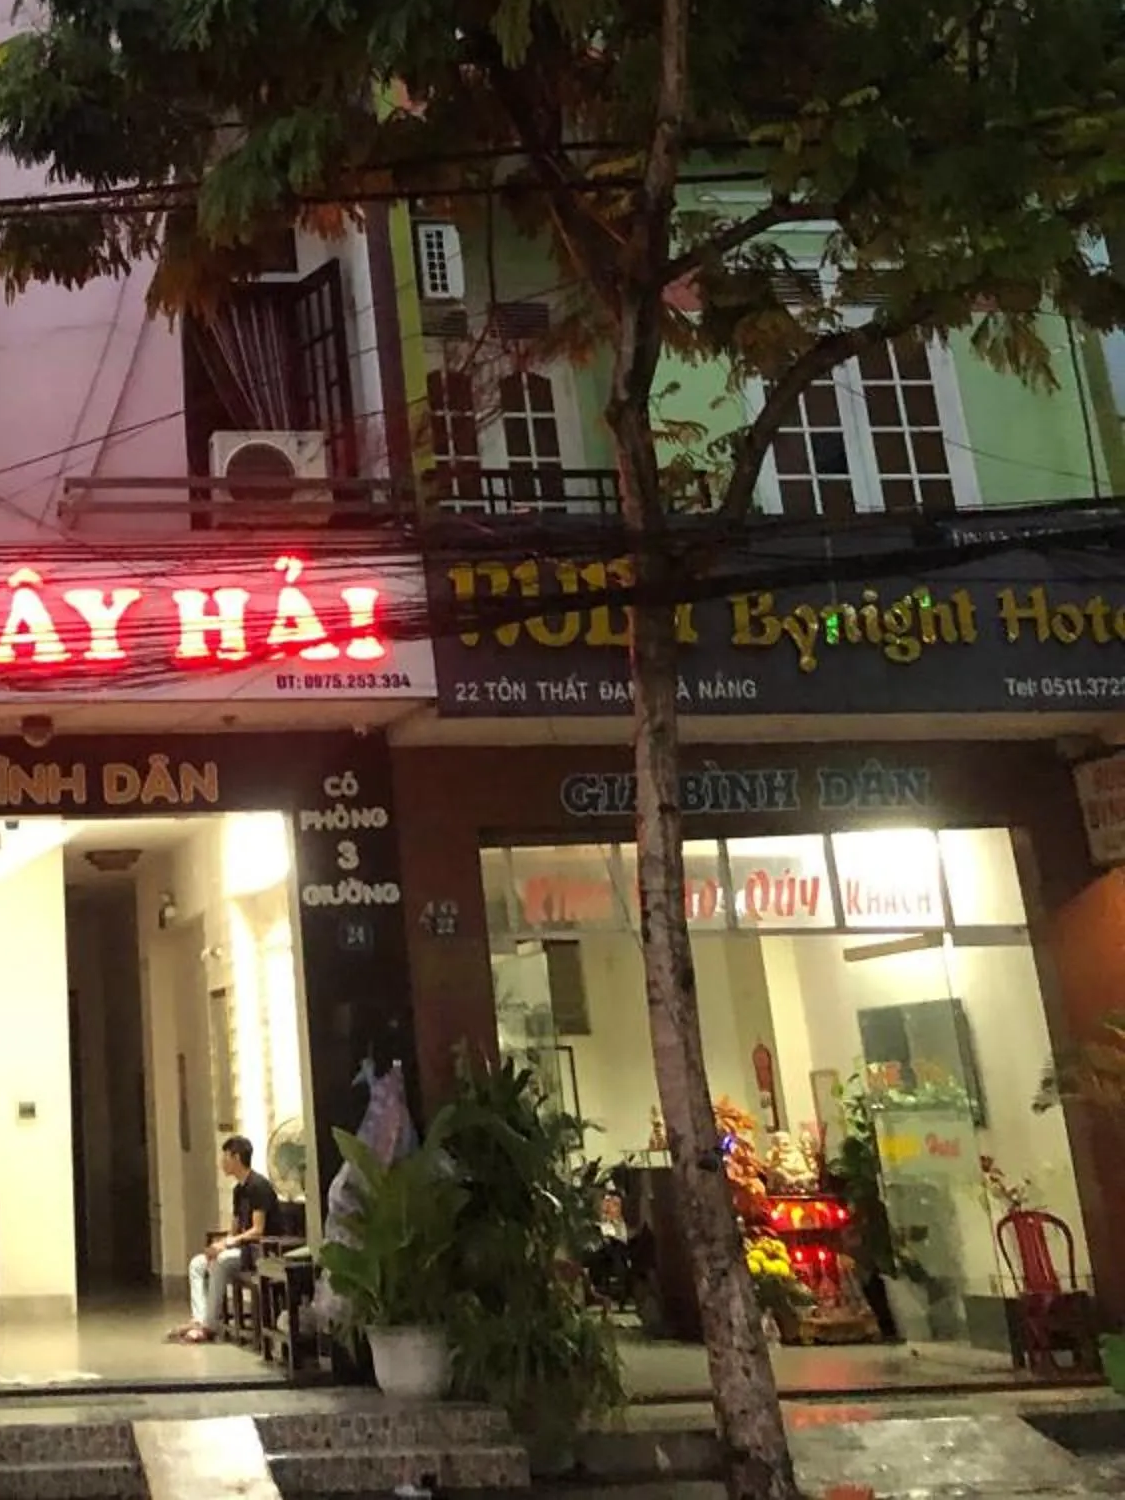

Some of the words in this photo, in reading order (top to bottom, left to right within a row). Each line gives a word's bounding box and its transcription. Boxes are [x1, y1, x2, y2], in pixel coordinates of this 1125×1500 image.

[173, 556, 385, 661] HẢI
[455, 682, 479, 700] 22
[485, 676, 526, 700] TÔN
[102, 753, 219, 804] DÂN
[324, 770, 359, 797] CÓ
[337, 840, 359, 870] 3
